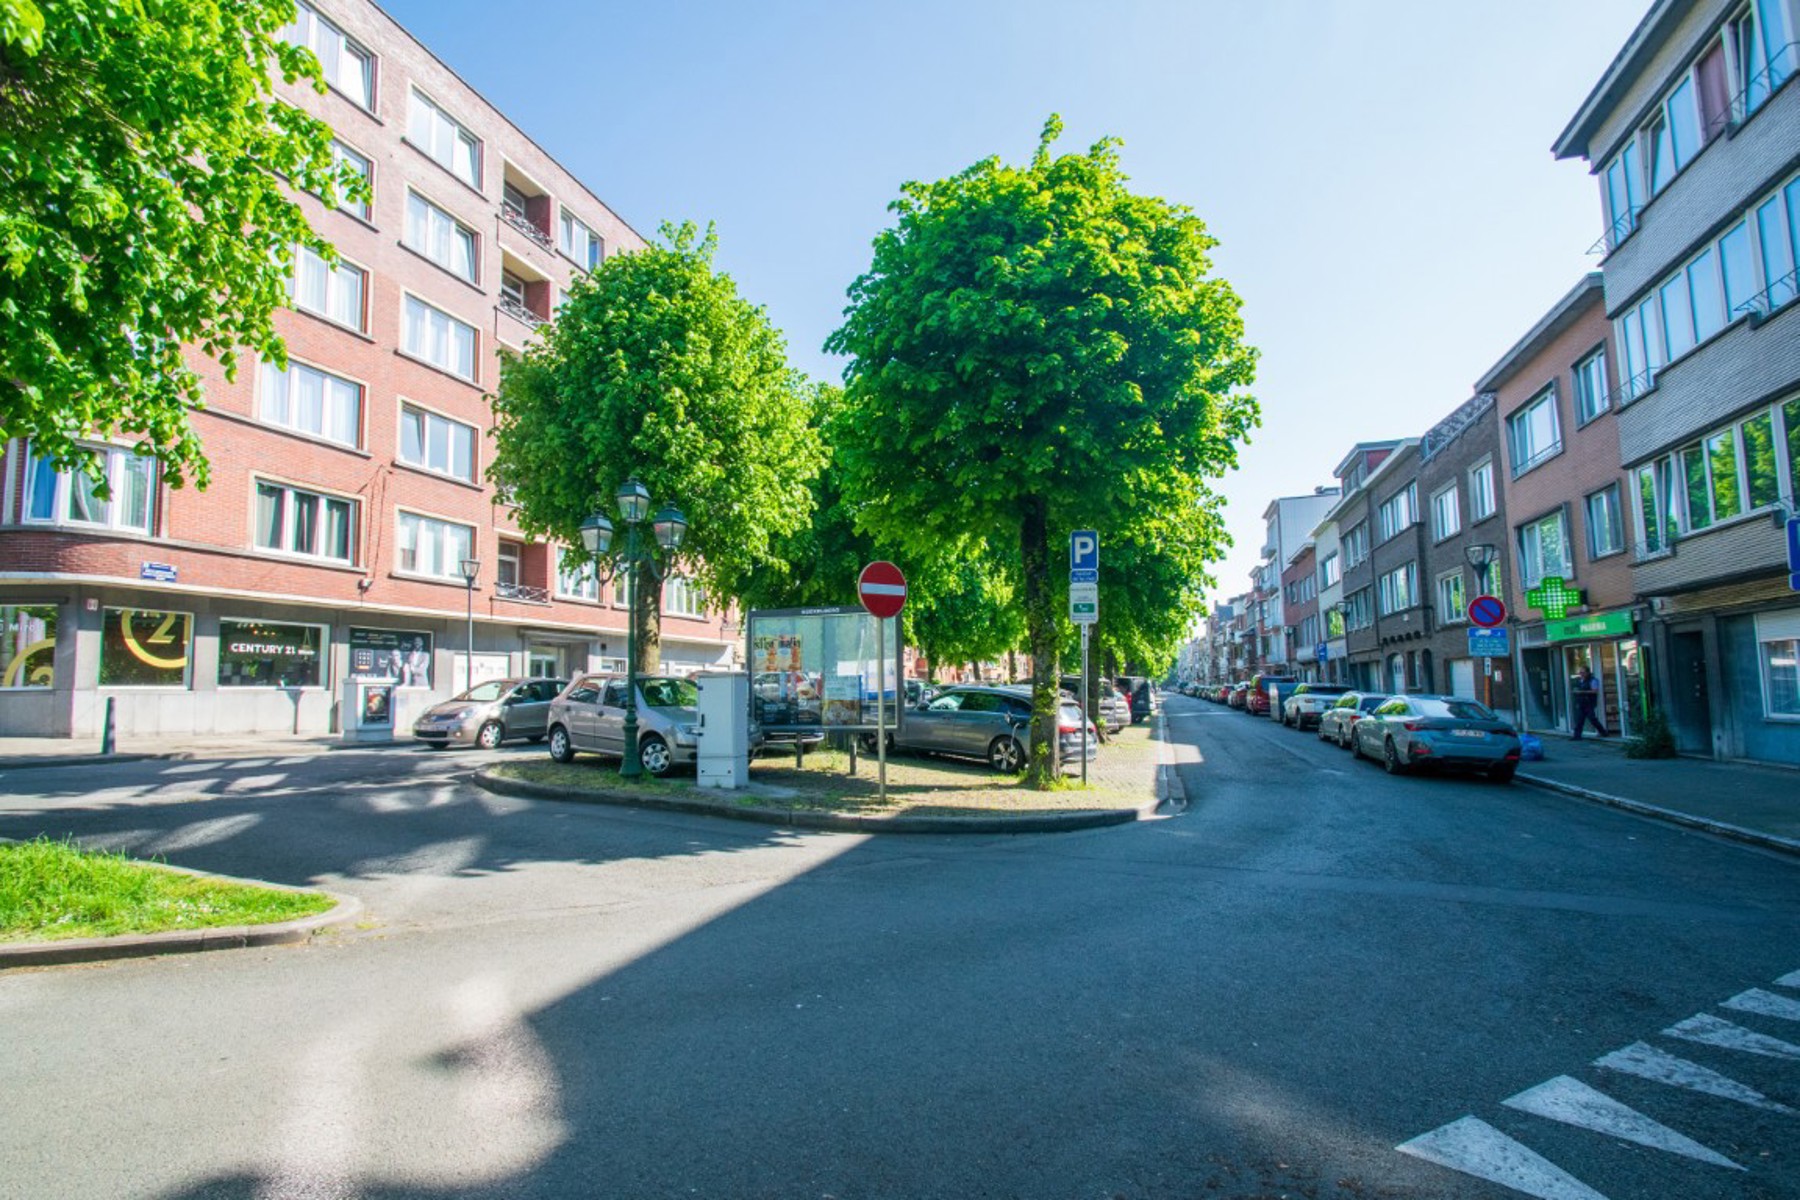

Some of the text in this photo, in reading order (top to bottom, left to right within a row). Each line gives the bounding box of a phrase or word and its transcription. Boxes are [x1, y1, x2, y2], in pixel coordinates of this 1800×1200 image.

[1075, 537, 1094, 563] P
[230, 643, 284, 654] CENTURY
[285, 645, 296, 655] 21
